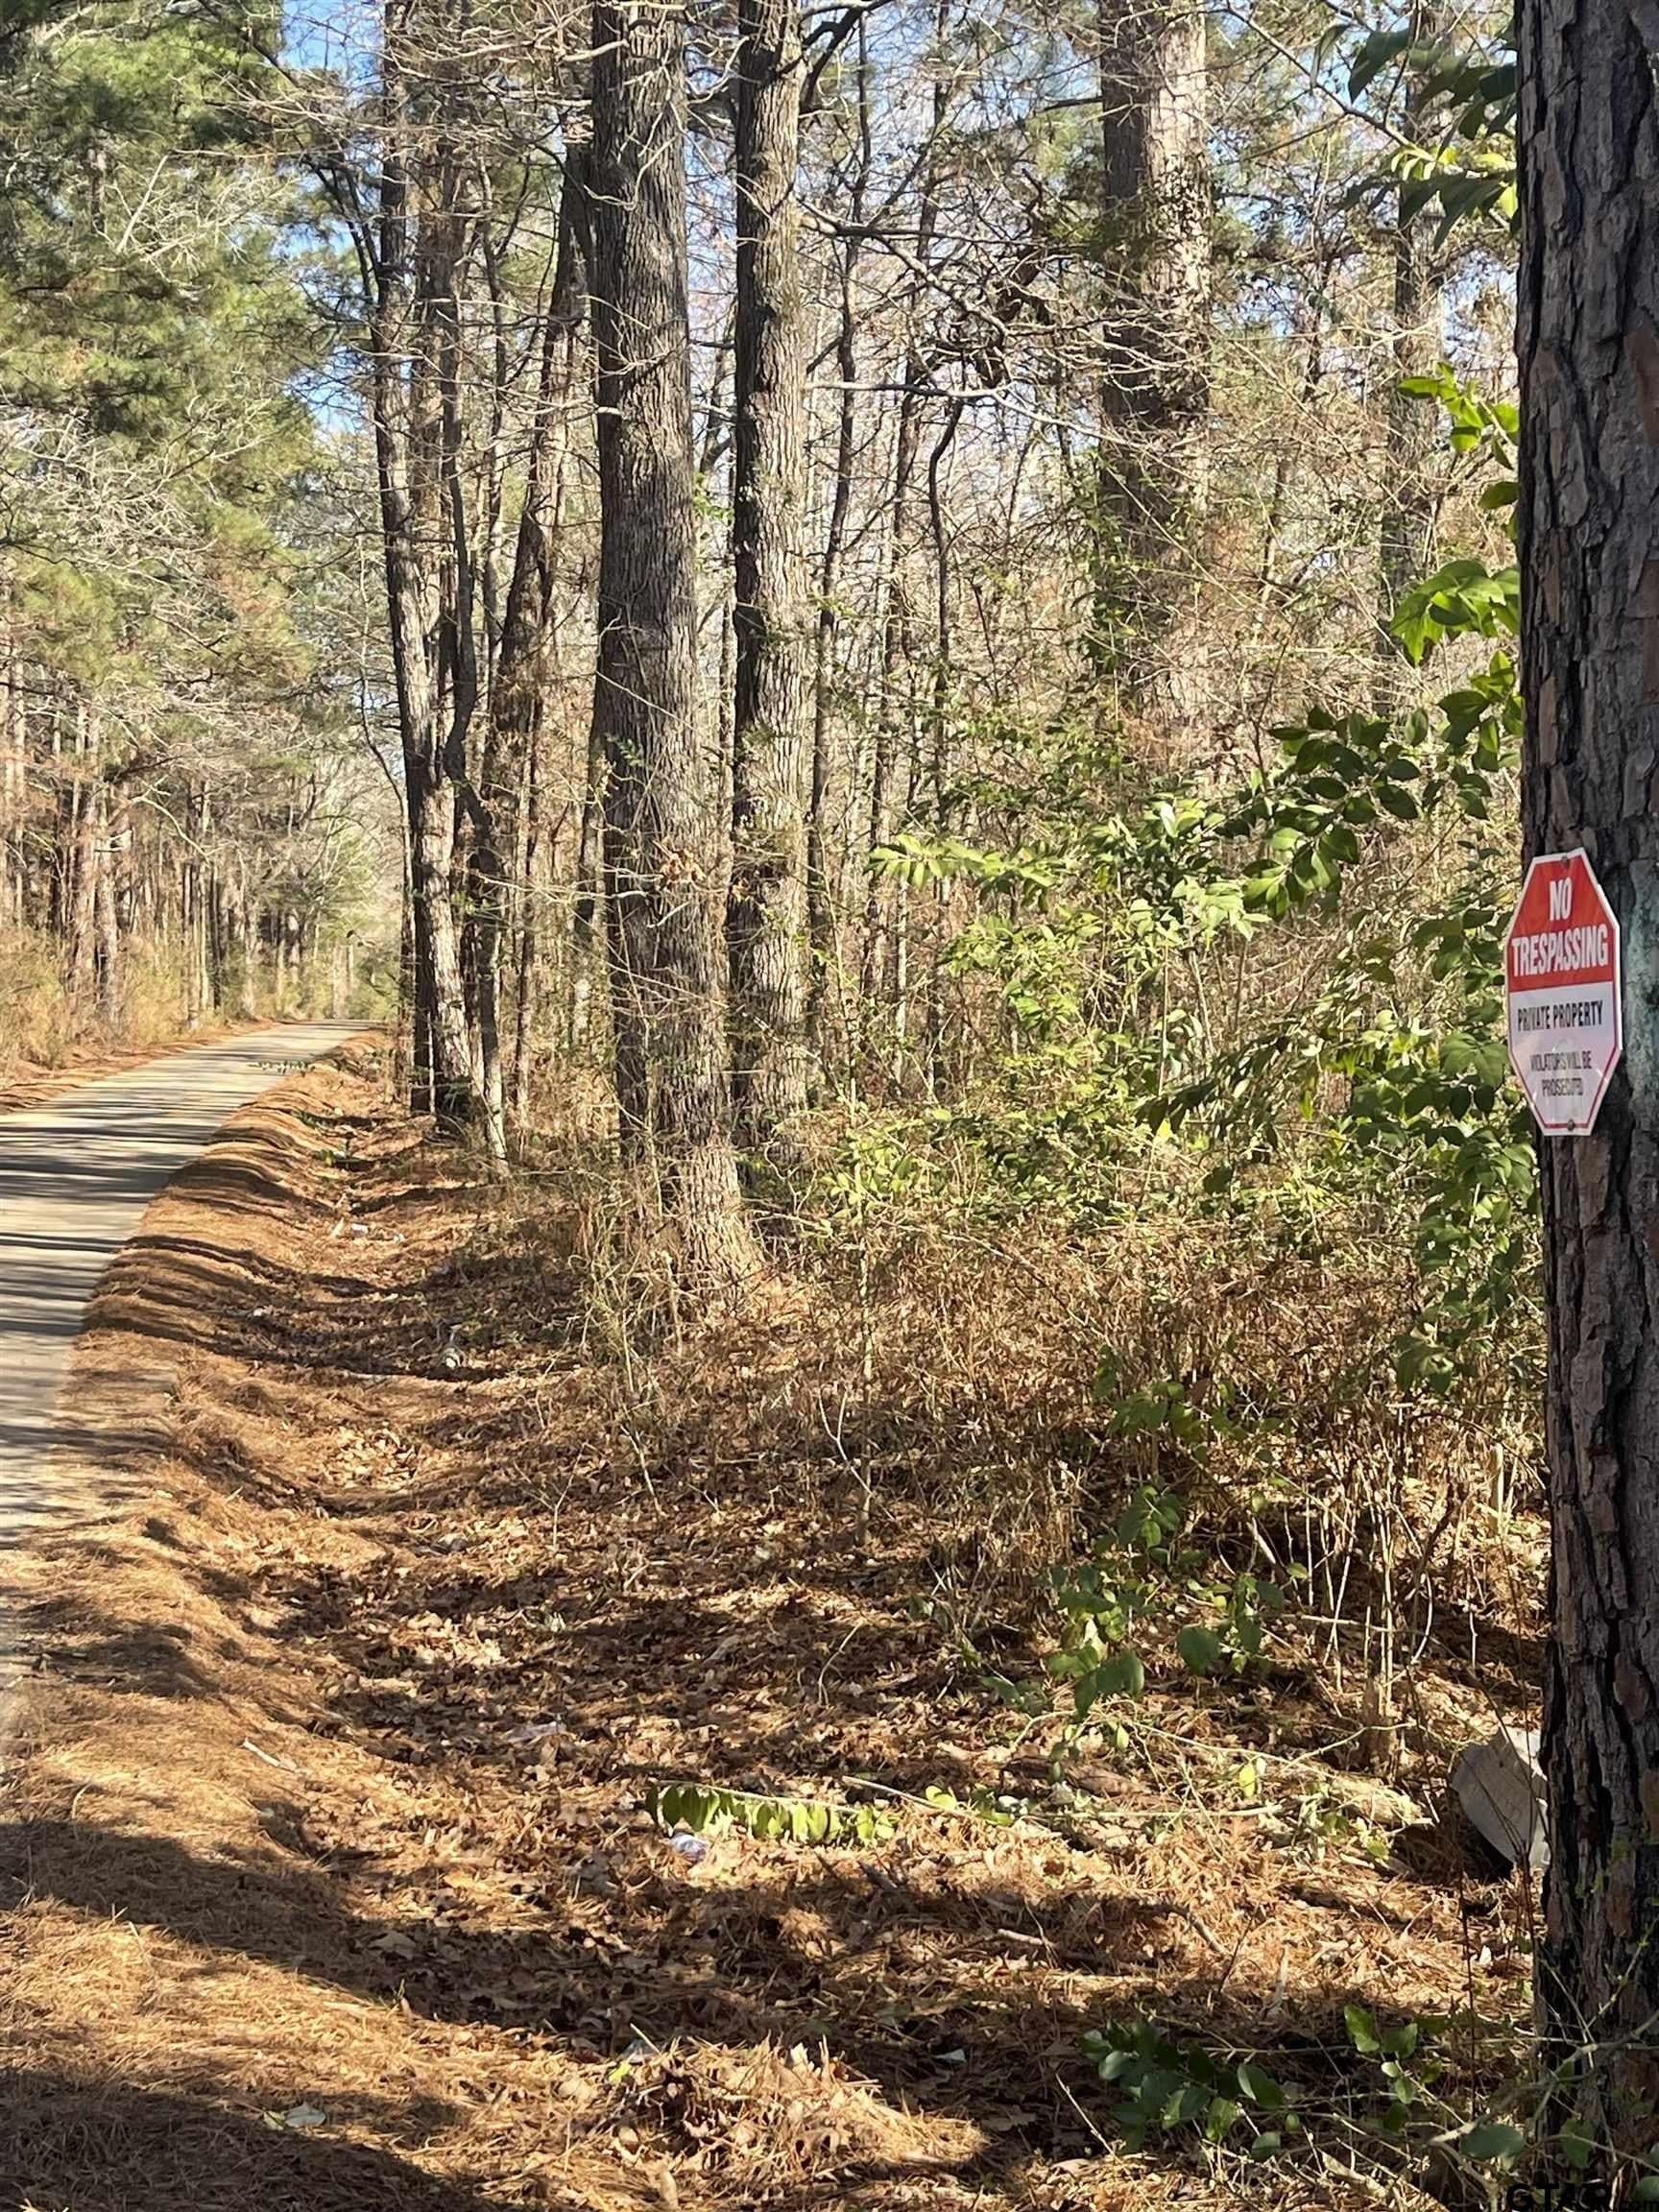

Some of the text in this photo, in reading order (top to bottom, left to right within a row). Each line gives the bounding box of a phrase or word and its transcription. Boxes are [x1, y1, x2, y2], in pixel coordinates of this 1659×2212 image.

[1550, 877, 1573, 921] NO
[1511, 924, 1609, 976] TRESPASSING
[1517, 999, 1603, 1032] PRIVATE PROPERTY
[1529, 1050, 1593, 1072] VIOLATORS WILL BE
